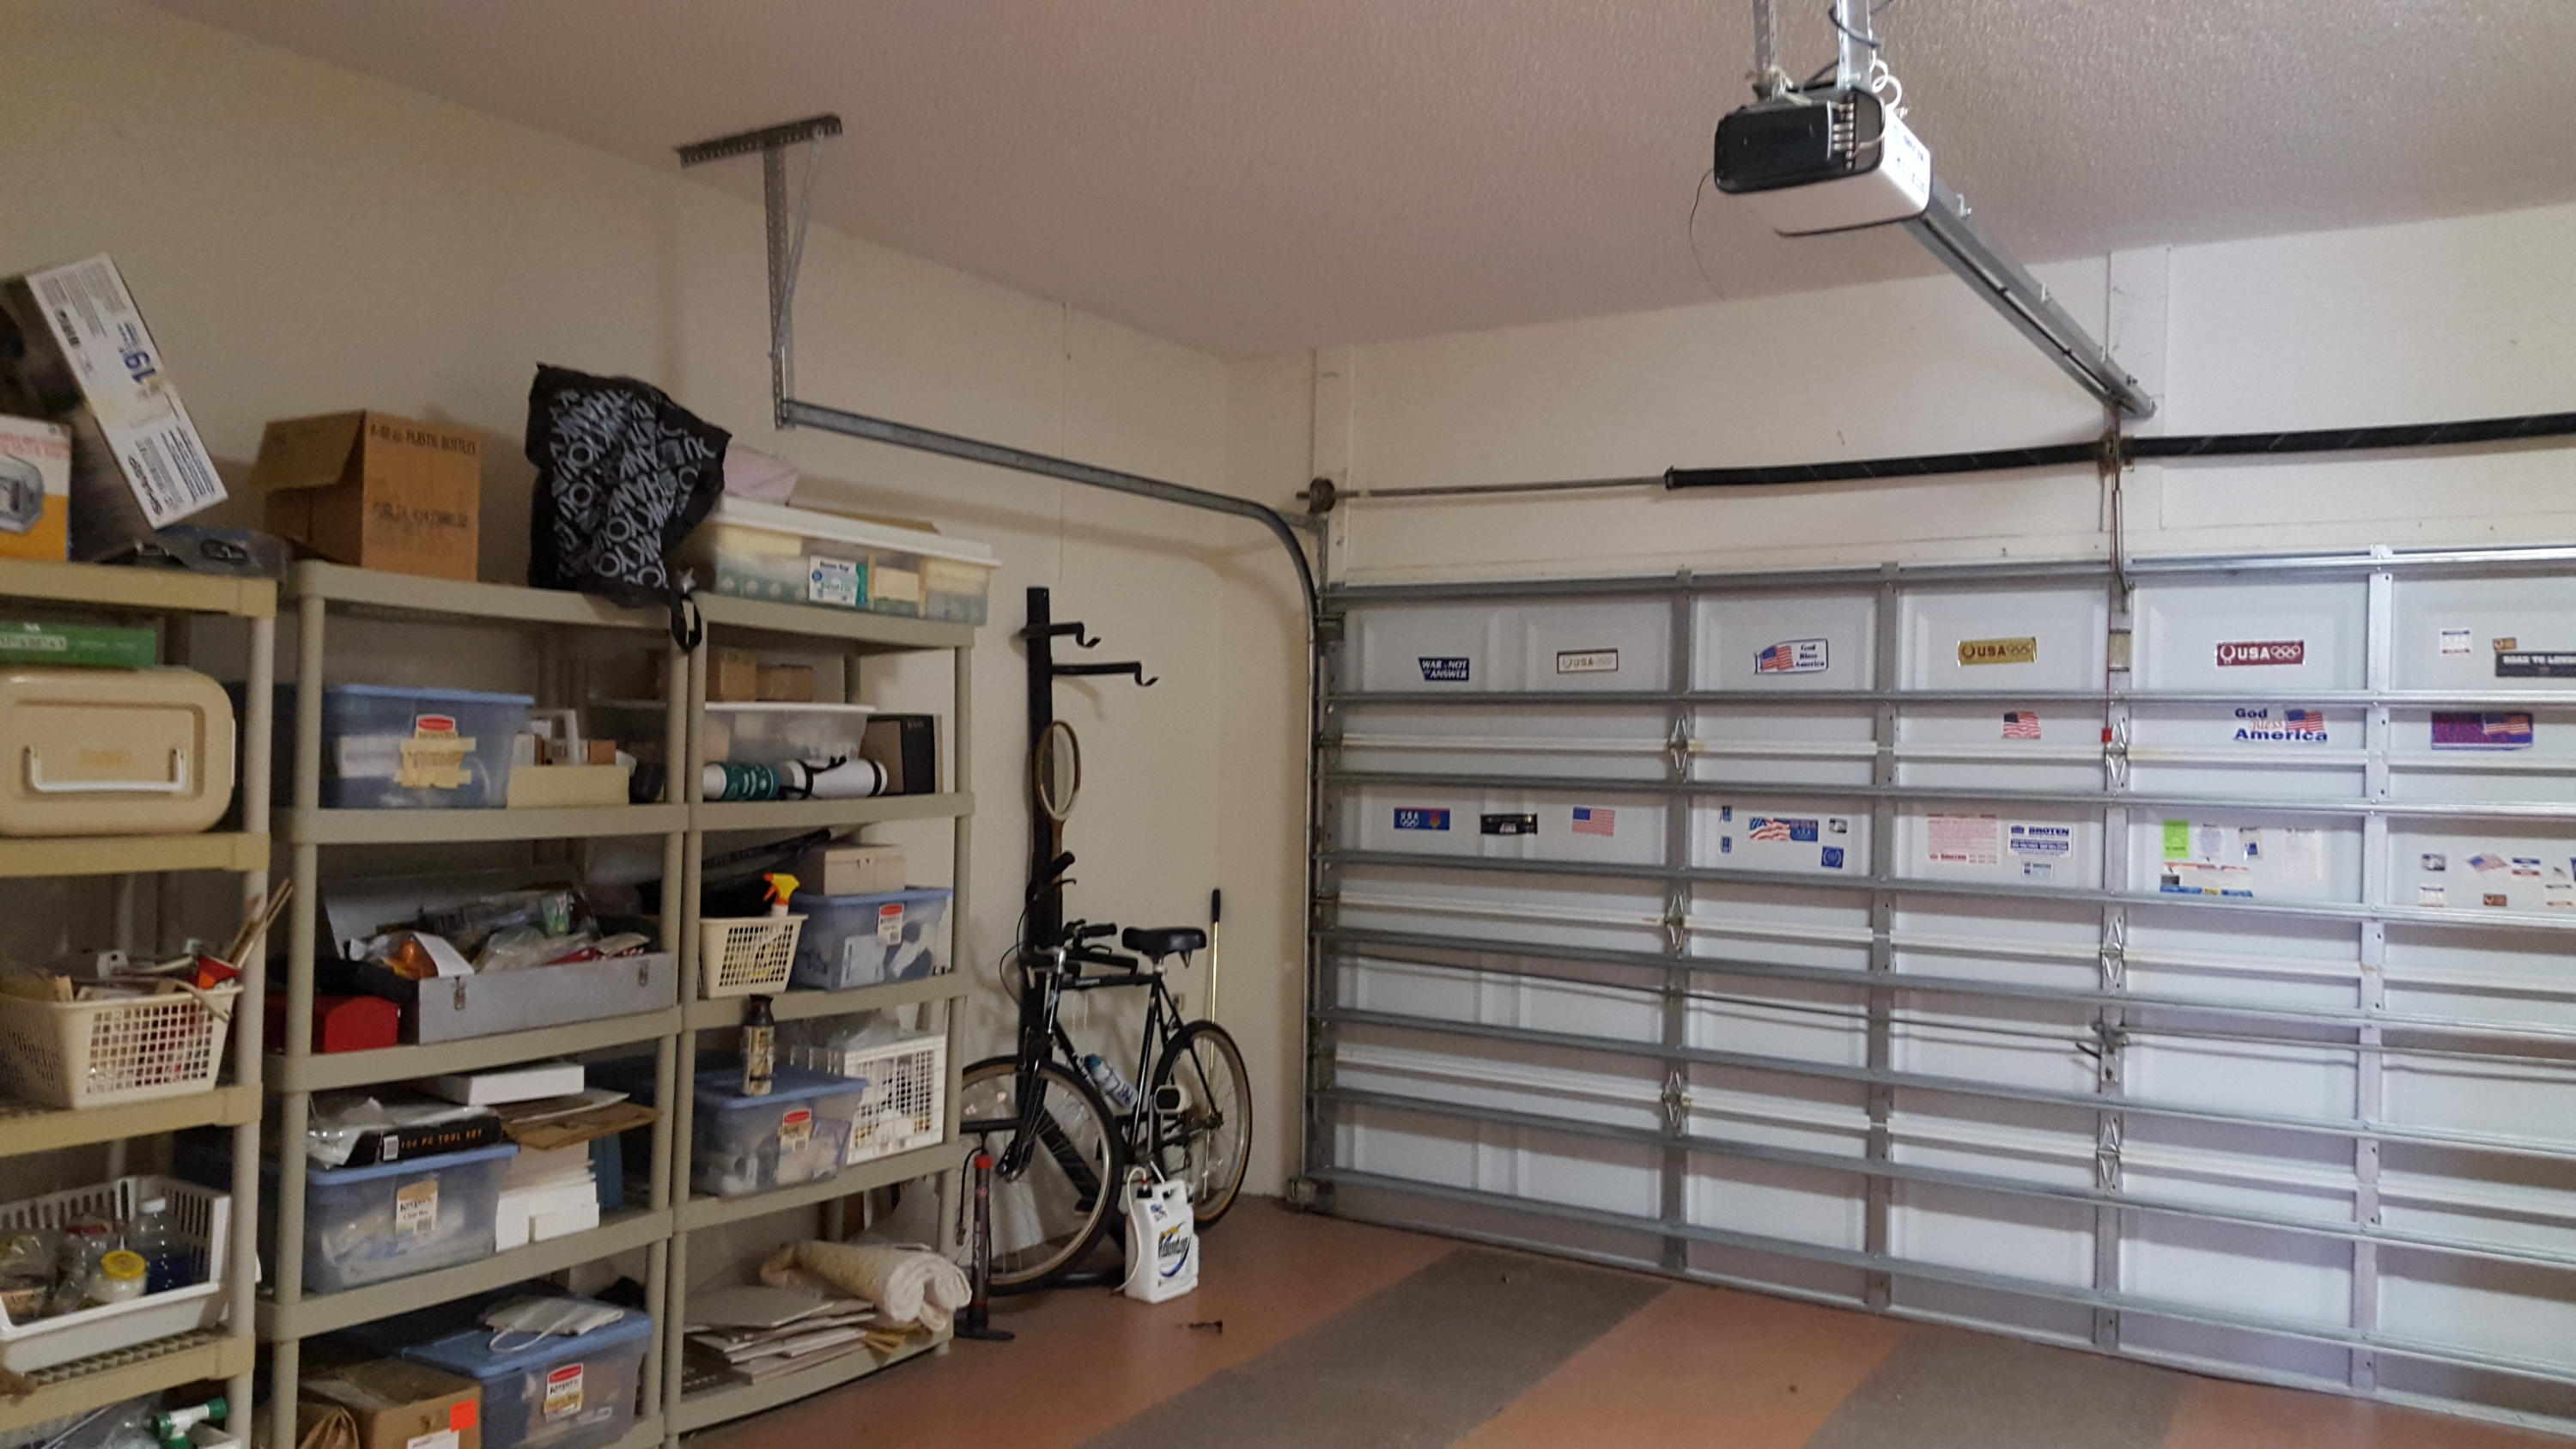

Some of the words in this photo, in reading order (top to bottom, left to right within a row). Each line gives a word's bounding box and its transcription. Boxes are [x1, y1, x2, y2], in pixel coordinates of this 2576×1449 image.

[128, 454, 163, 516] SHARP
[1978, 645, 2006, 657] USA
[2238, 646, 2269, 661] USA
[1422, 660, 1443, 669] WAR
[1448, 660, 1468, 669] NOT
[2530, 655, 2546, 665] TO
[1430, 670, 1468, 679] ANSWER
[2234, 708, 2268, 719] God
[2234, 728, 2328, 741] America
[439, 1133, 461, 1144] TOOL
